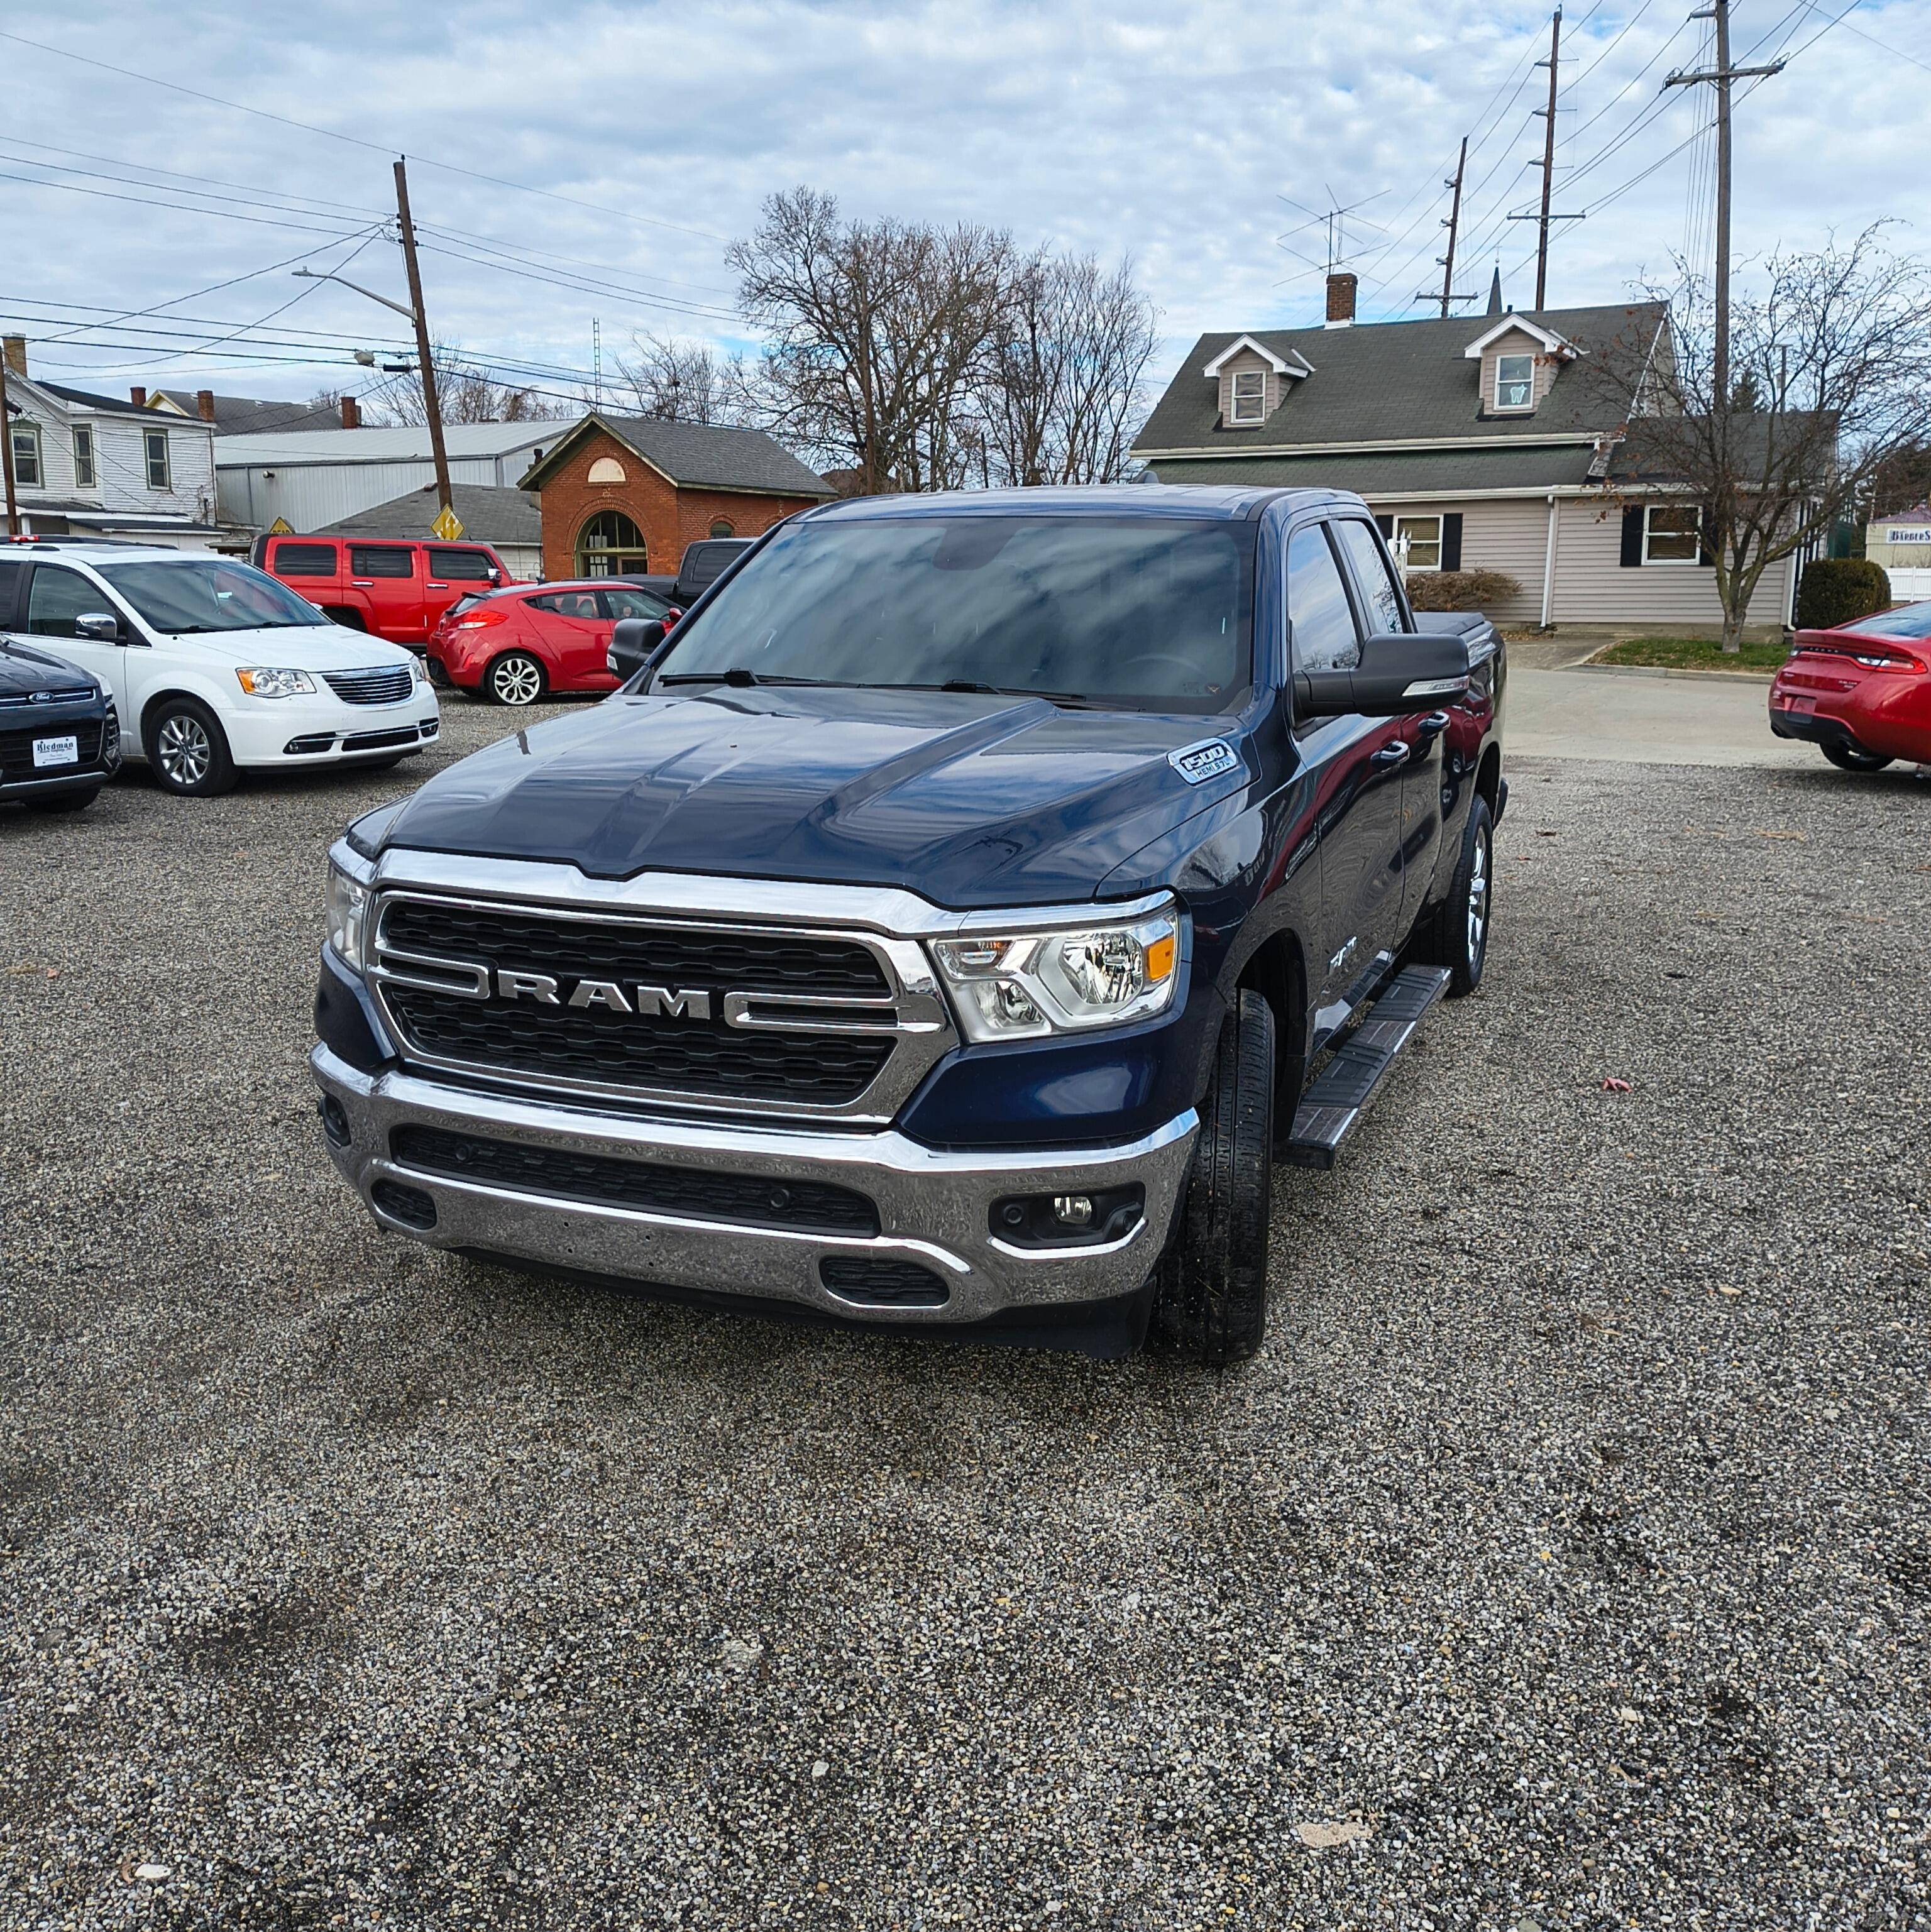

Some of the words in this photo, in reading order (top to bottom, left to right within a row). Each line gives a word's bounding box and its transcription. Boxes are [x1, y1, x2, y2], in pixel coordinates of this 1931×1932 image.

[1181, 746, 1225, 771] 1500
[1196, 764, 1216, 777] HEMI
[497, 969, 710, 1020] RAM
